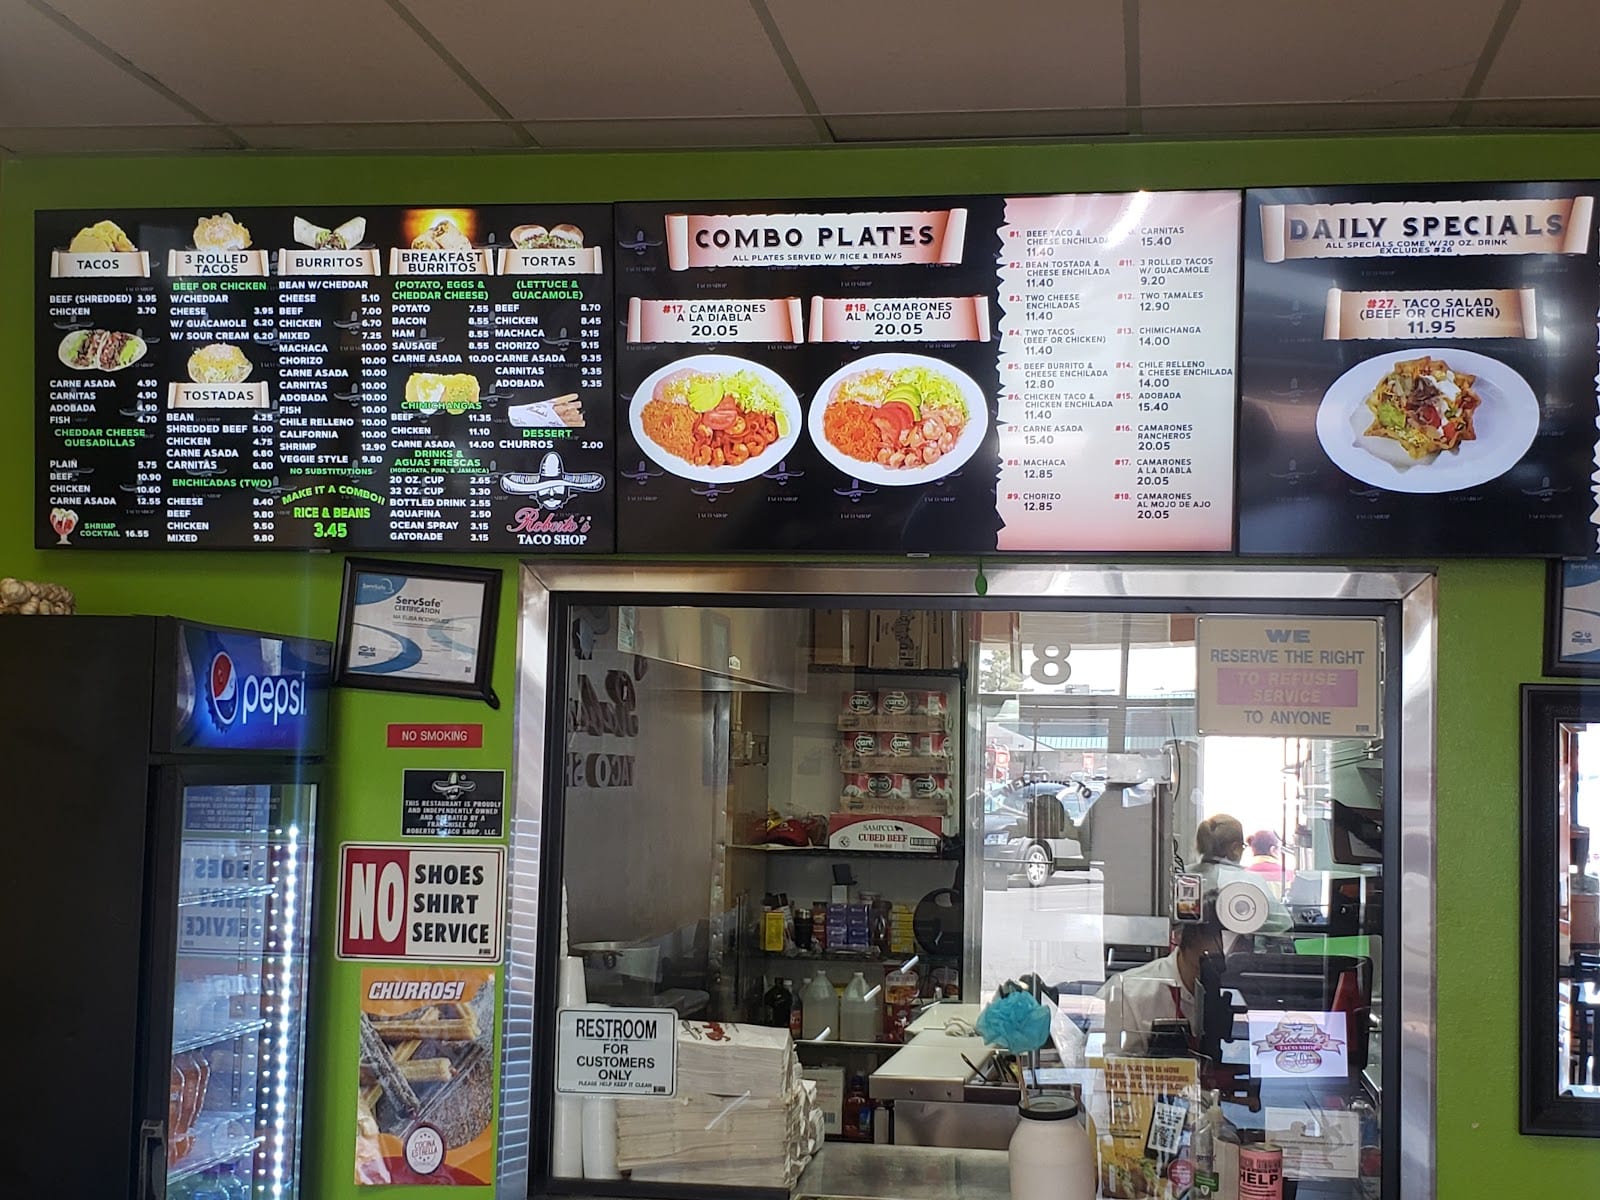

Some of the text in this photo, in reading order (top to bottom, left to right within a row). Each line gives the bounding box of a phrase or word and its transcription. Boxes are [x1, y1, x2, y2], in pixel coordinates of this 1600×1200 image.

[1141, 227, 1184, 235] CARNITAS
[1289, 215, 1563, 241] DAILY SPECIALS
[696, 226, 934, 248] COMBO PLATES
[1141, 237, 1171, 246] 15.40
[185, 254, 248, 264] 3 ROLLED
[295, 257, 363, 267] BURRITOS
[402, 252, 483, 262] BREAKFAST
[522, 257, 576, 266] TORTAS
[1148, 258, 1182, 266] ROLLED
[77, 259, 119, 270] TACOS
[195, 264, 238, 274] TACOS
[408, 263, 477, 272] BURRITOS
[1154, 266, 1209, 274] GUACAMOLE
[172, 281, 267, 291] BEEF OR CHICKEN
[1140, 277, 1165, 285] 9.20
[50, 294, 157, 304] BEEF (SHREDDED) 3.95
[1367, 298, 1493, 309] #27. TACO SALAD
[50, 306, 157, 315] CHICKEN 3.70
[662, 304, 766, 314] #17. CAMARONES
[845, 302, 953, 312] #18. CAMARONES
[1139, 302, 1170, 311] 12.90
[676, 313, 752, 322] A LA DIABLA
[846, 311, 951, 321] AL MOJO DE AJO
[1359, 307, 1501, 320] (BEEF OR CHICKEN)
[691, 325, 739, 337] 20.05
[874, 323, 923, 335] 20.05
[1407, 321, 1456, 334] 11.95
[1139, 337, 1170, 346] 14.00
[183, 391, 254, 401] TOSTADAS
[54, 428, 146, 437] CHEDDAR CHEESE
[1138, 424, 1193, 432] CAMARONES
[522, 430, 573, 438] DESSERT
[64, 439, 135, 447] QUESADILLAS
[499, 440, 604, 449] CHURROS 2.00
[1138, 442, 1170, 451] 20.05
[414, 450, 463, 458] DRINKS &
[395, 459, 481, 467] AGUAS FRESCAS
[172, 478, 272, 488] ENCHILADAS (TWO)
[389, 476, 401, 484] 20
[404, 476, 422, 484] OZ.
[424, 476, 444, 484] CUP
[1024, 502, 1052, 511] 12.85
[293, 507, 371, 519] RICE & BEANS
[313, 522, 348, 538] 3.45
[517, 534, 587, 545] TACO SHOP
[395, 595, 441, 608] ServSafe
[394, 605, 440, 615] CERTIFICATION
[1265, 629, 1310, 643] WE
[1211, 649, 1365, 665] RESERVE THE RIGHT
[1030, 640, 1072, 685] 8
[1237, 672, 1338, 686] TO REFUSE
[242, 671, 306, 726] pepsi
[1252, 689, 1322, 703] SERVICE
[1243, 710, 1331, 725] TO ANYONE
[402, 731, 468, 741] NO SMOKING
[858, 833, 908, 842] CUBED BEEF
[414, 864, 484, 885] SHOES
[349, 861, 405, 943] NO
[413, 893, 480, 915] SHIRT
[412, 922, 489, 944] SERVICE
[368, 981, 465, 1000] CHURROS!
[576, 1018, 657, 1039] RESTROOM
[603, 1044, 629, 1054] FOR
[576, 1056, 655, 1068] CUSTOMERS
[598, 1069, 632, 1081] ONLY
[1240, 1172, 1278, 1185] HELP
